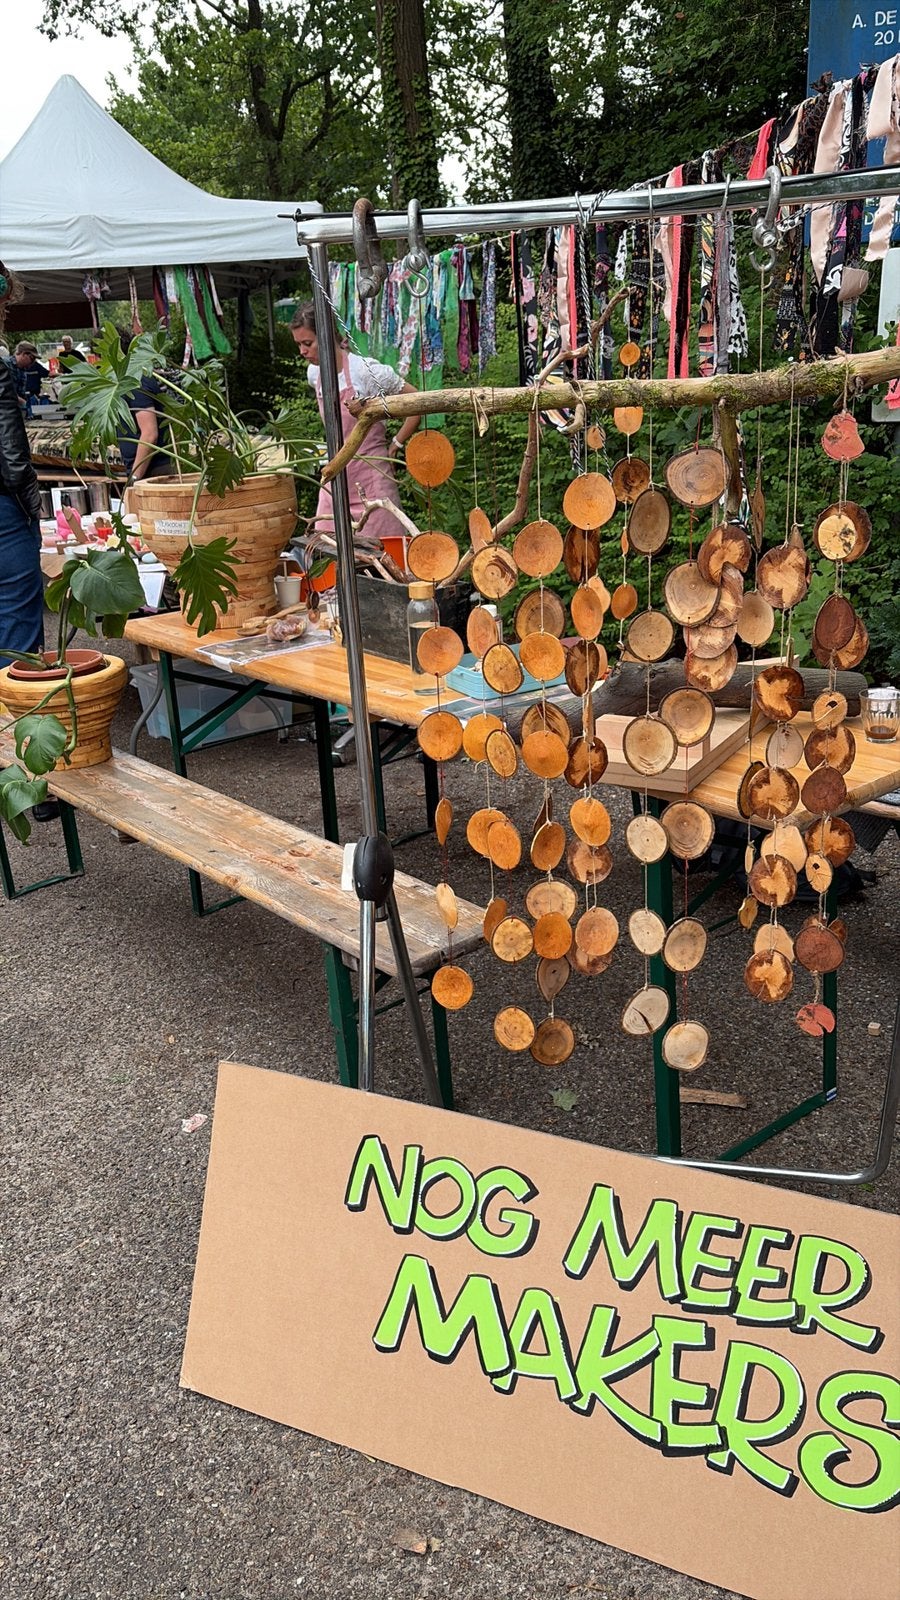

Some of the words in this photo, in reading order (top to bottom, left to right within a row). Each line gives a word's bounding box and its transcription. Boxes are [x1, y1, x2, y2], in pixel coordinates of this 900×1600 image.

[852, 13, 867, 29] A.
[874, 29, 895, 46] 20
[345, 1134, 539, 1258] NOG
[563, 1182, 885, 1354] MEER
[373, 1254, 900, 1513] MAKERS
